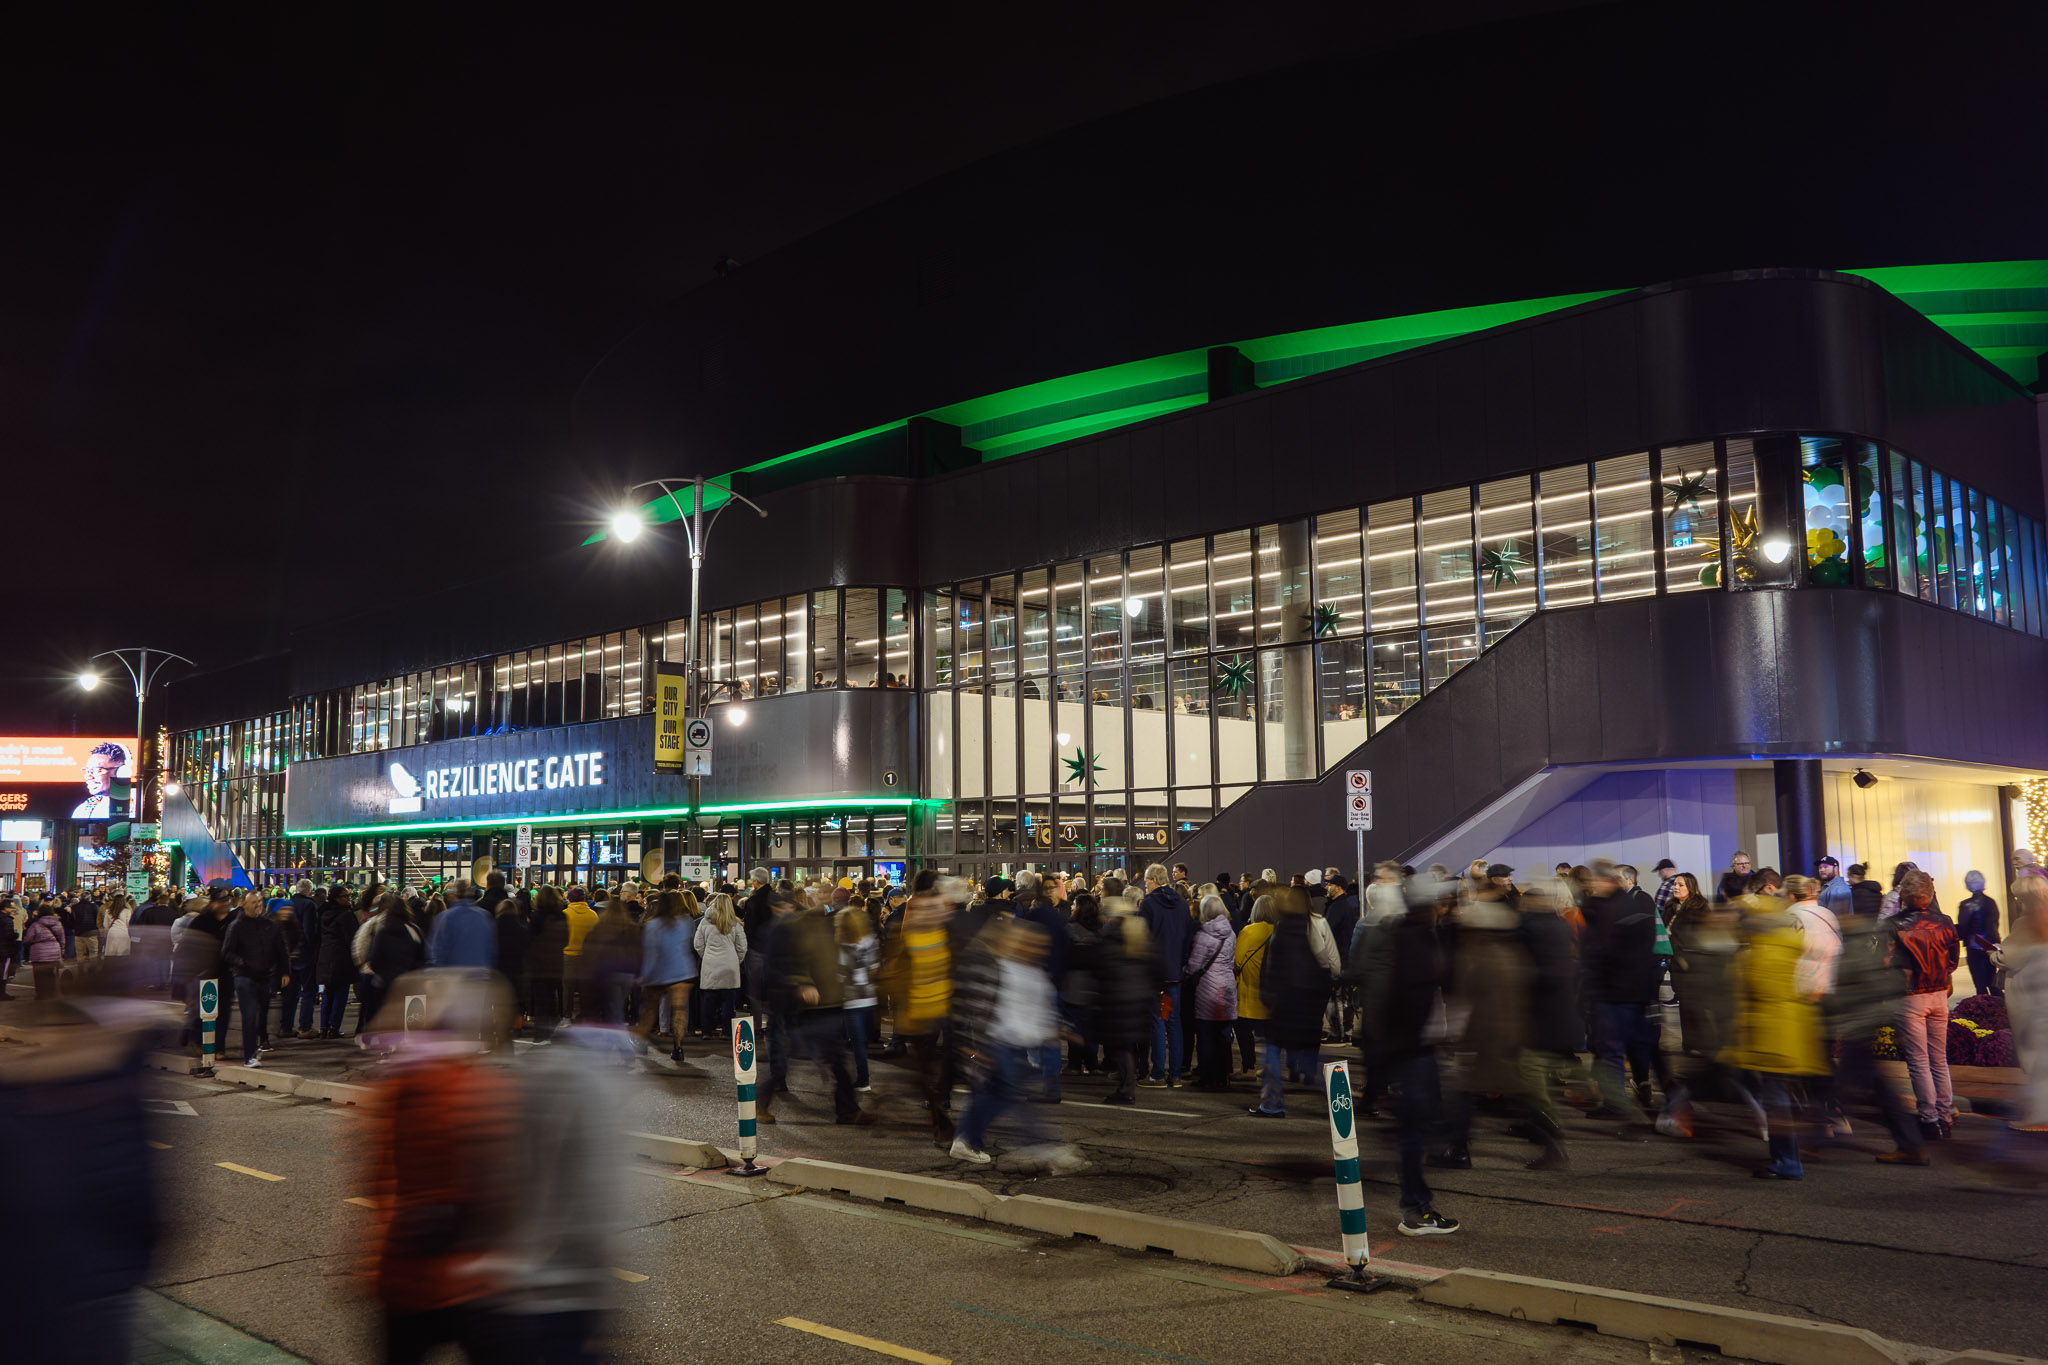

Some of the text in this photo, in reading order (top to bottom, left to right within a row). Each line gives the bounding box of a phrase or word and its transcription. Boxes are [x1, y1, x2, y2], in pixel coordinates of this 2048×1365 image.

[664, 686, 678, 701] OUR
[663, 701, 678, 716] CITY
[663, 719, 677, 734] OUR
[659, 734, 680, 750] STAGE
[426, 752, 602, 799] REZILIENCE GATE
[887, 773, 893, 785] 1
[1066, 826, 1072, 839] 1
